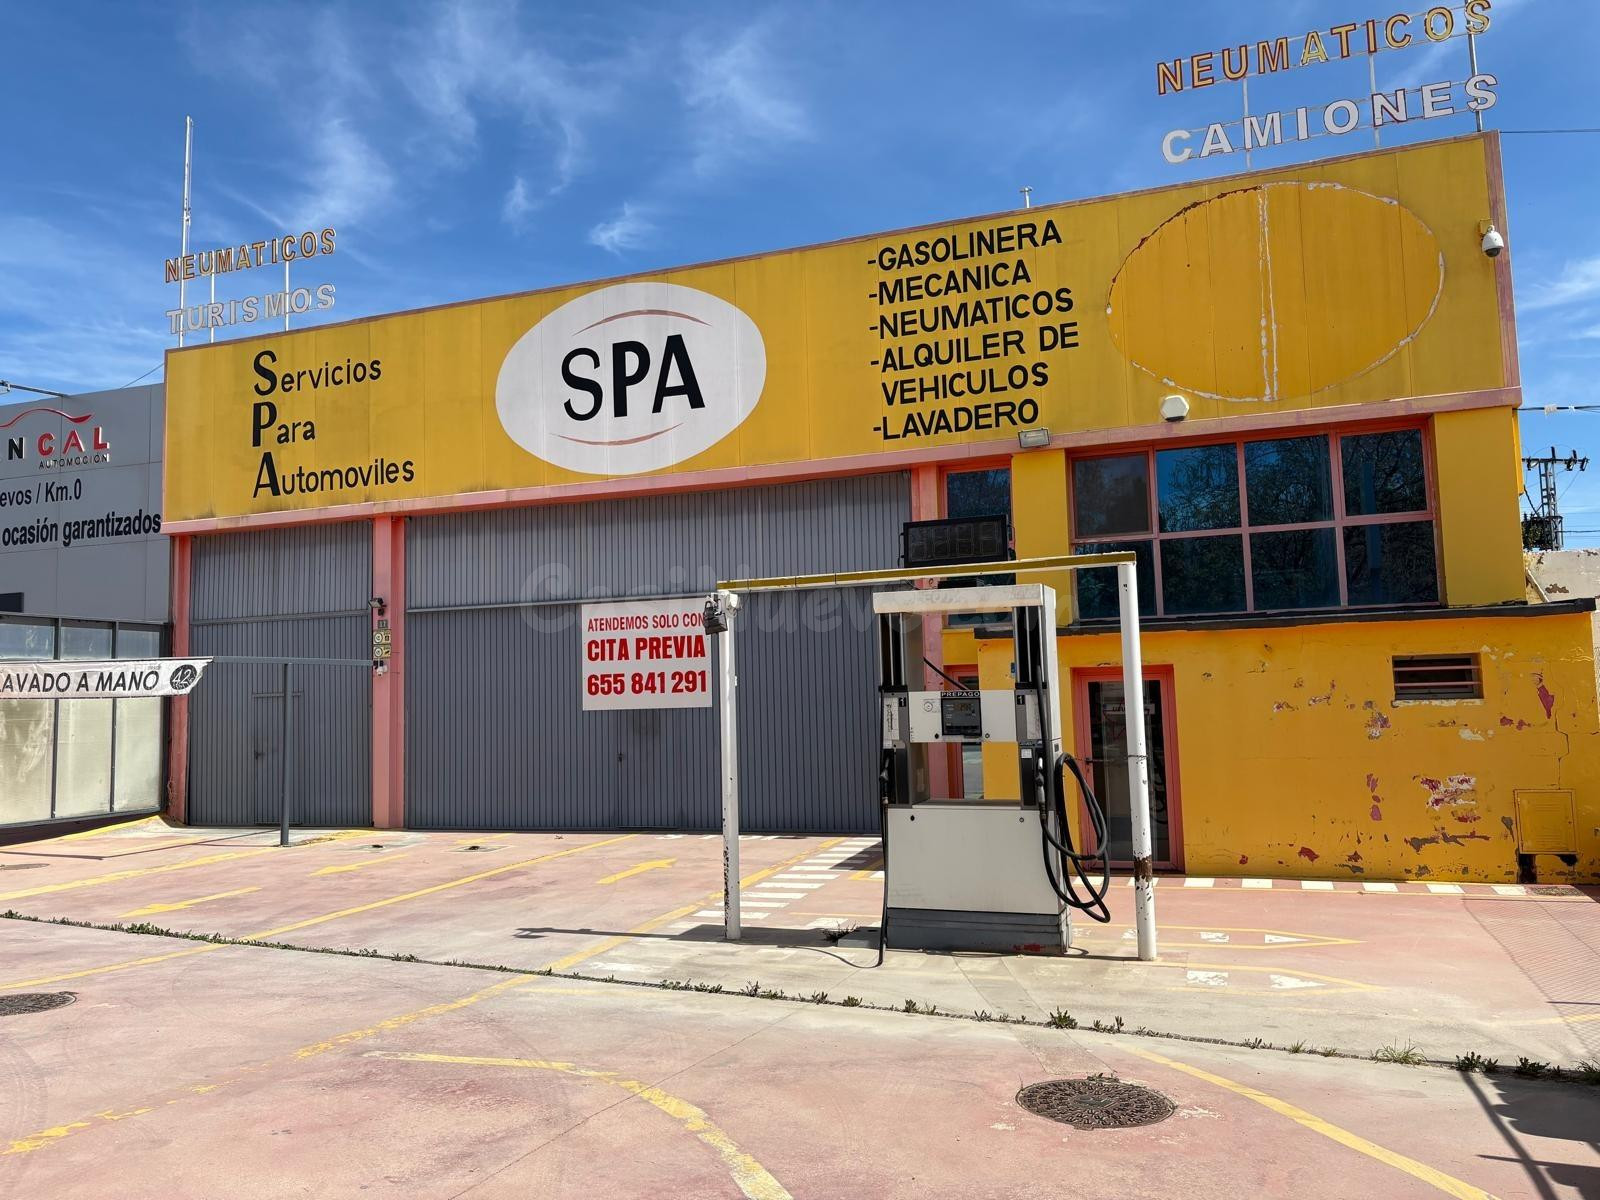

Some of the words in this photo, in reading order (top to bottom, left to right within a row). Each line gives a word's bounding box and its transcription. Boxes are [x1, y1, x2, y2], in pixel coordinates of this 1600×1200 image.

[1157, 0, 1493, 96] NEUMATICOS
[1162, 73, 1498, 165] CAMIONES
[165, 228, 336, 283] NEUMATICOS
[166, 284, 336, 334] TURISMOS
[1039, 321, 1079, 352] DE
[253, 350, 382, 396] Servicios
[561, 333, 706, 422] SPA
[881, 361, 1049, 406] VEHICULOS
[252, 401, 316, 448] Para
[45, 478, 82, 503] Km.0
[252, 451, 415, 499] Automoviles
[2, 517, 58, 547] ocasión
[62, 508, 161, 548] garantizados
[587, 615, 649, 632] ATENDEMOS
[652, 613, 679, 629] SOLO
[682, 612, 704, 628] CON
[587, 638, 630, 662] CITA
[635, 634, 706, 660] PREVIA
[0, 671, 71, 692] AVADO
[76, 672, 90, 692] A
[95, 670, 160, 692] MANO
[171, 668, 192, 684] 42
[587, 673, 626, 696] 655
[631, 671, 666, 694] 841
[671, 670, 707, 693] 291
